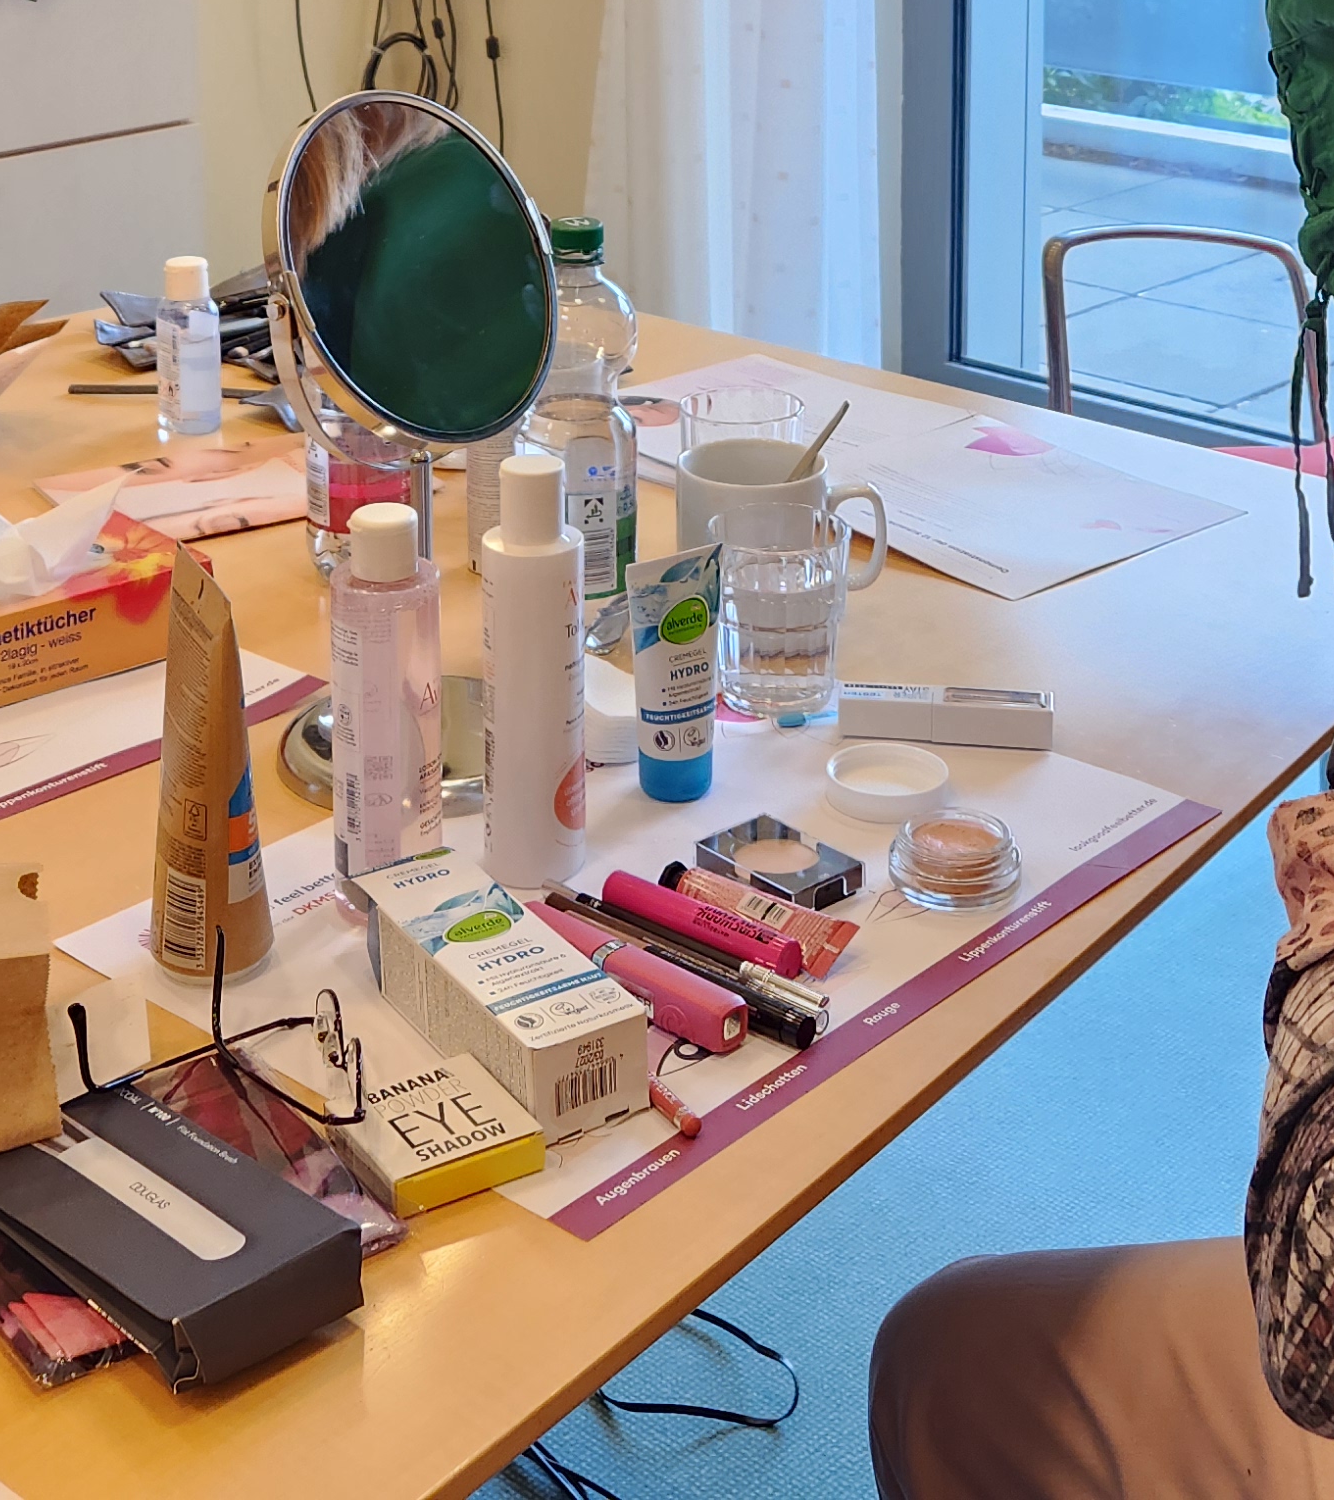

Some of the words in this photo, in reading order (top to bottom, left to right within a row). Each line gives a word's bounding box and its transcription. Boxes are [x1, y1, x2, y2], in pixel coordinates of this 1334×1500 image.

[666, 612, 703, 631] alverde
[0, 642, 38, 663] 2lagig
[48, 630, 82, 648] weiss
[670, 661, 709, 681] HYDRO
[1069, 797, 1158, 852] lookgoodfeelbetter.de
[385, 861, 441, 880] CREMEGEL
[393, 868, 451, 889] HYDRO
[273, 889, 303, 910] feel
[304, 871, 336, 892] bett
[453, 916, 504, 938] alverde
[957, 899, 1052, 963] Lippenkonturenstift
[467, 937, 533, 960] CREMEGEL
[477, 946, 545, 971] HYDRO
[577, 1003, 635, 1026] Naturkosmetik
[862, 1000, 902, 1028] Rouge
[367, 1068, 451, 1105] BANANA
[373, 1078, 468, 1119] POWDER
[735, 1063, 808, 1112] Lidschatten
[388, 1092, 498, 1150] EYE
[415, 1122, 507, 1163] SHADOW
[595, 1147, 681, 1207] Augenbrauen
[128, 1181, 171, 1210] DOUGLAS
